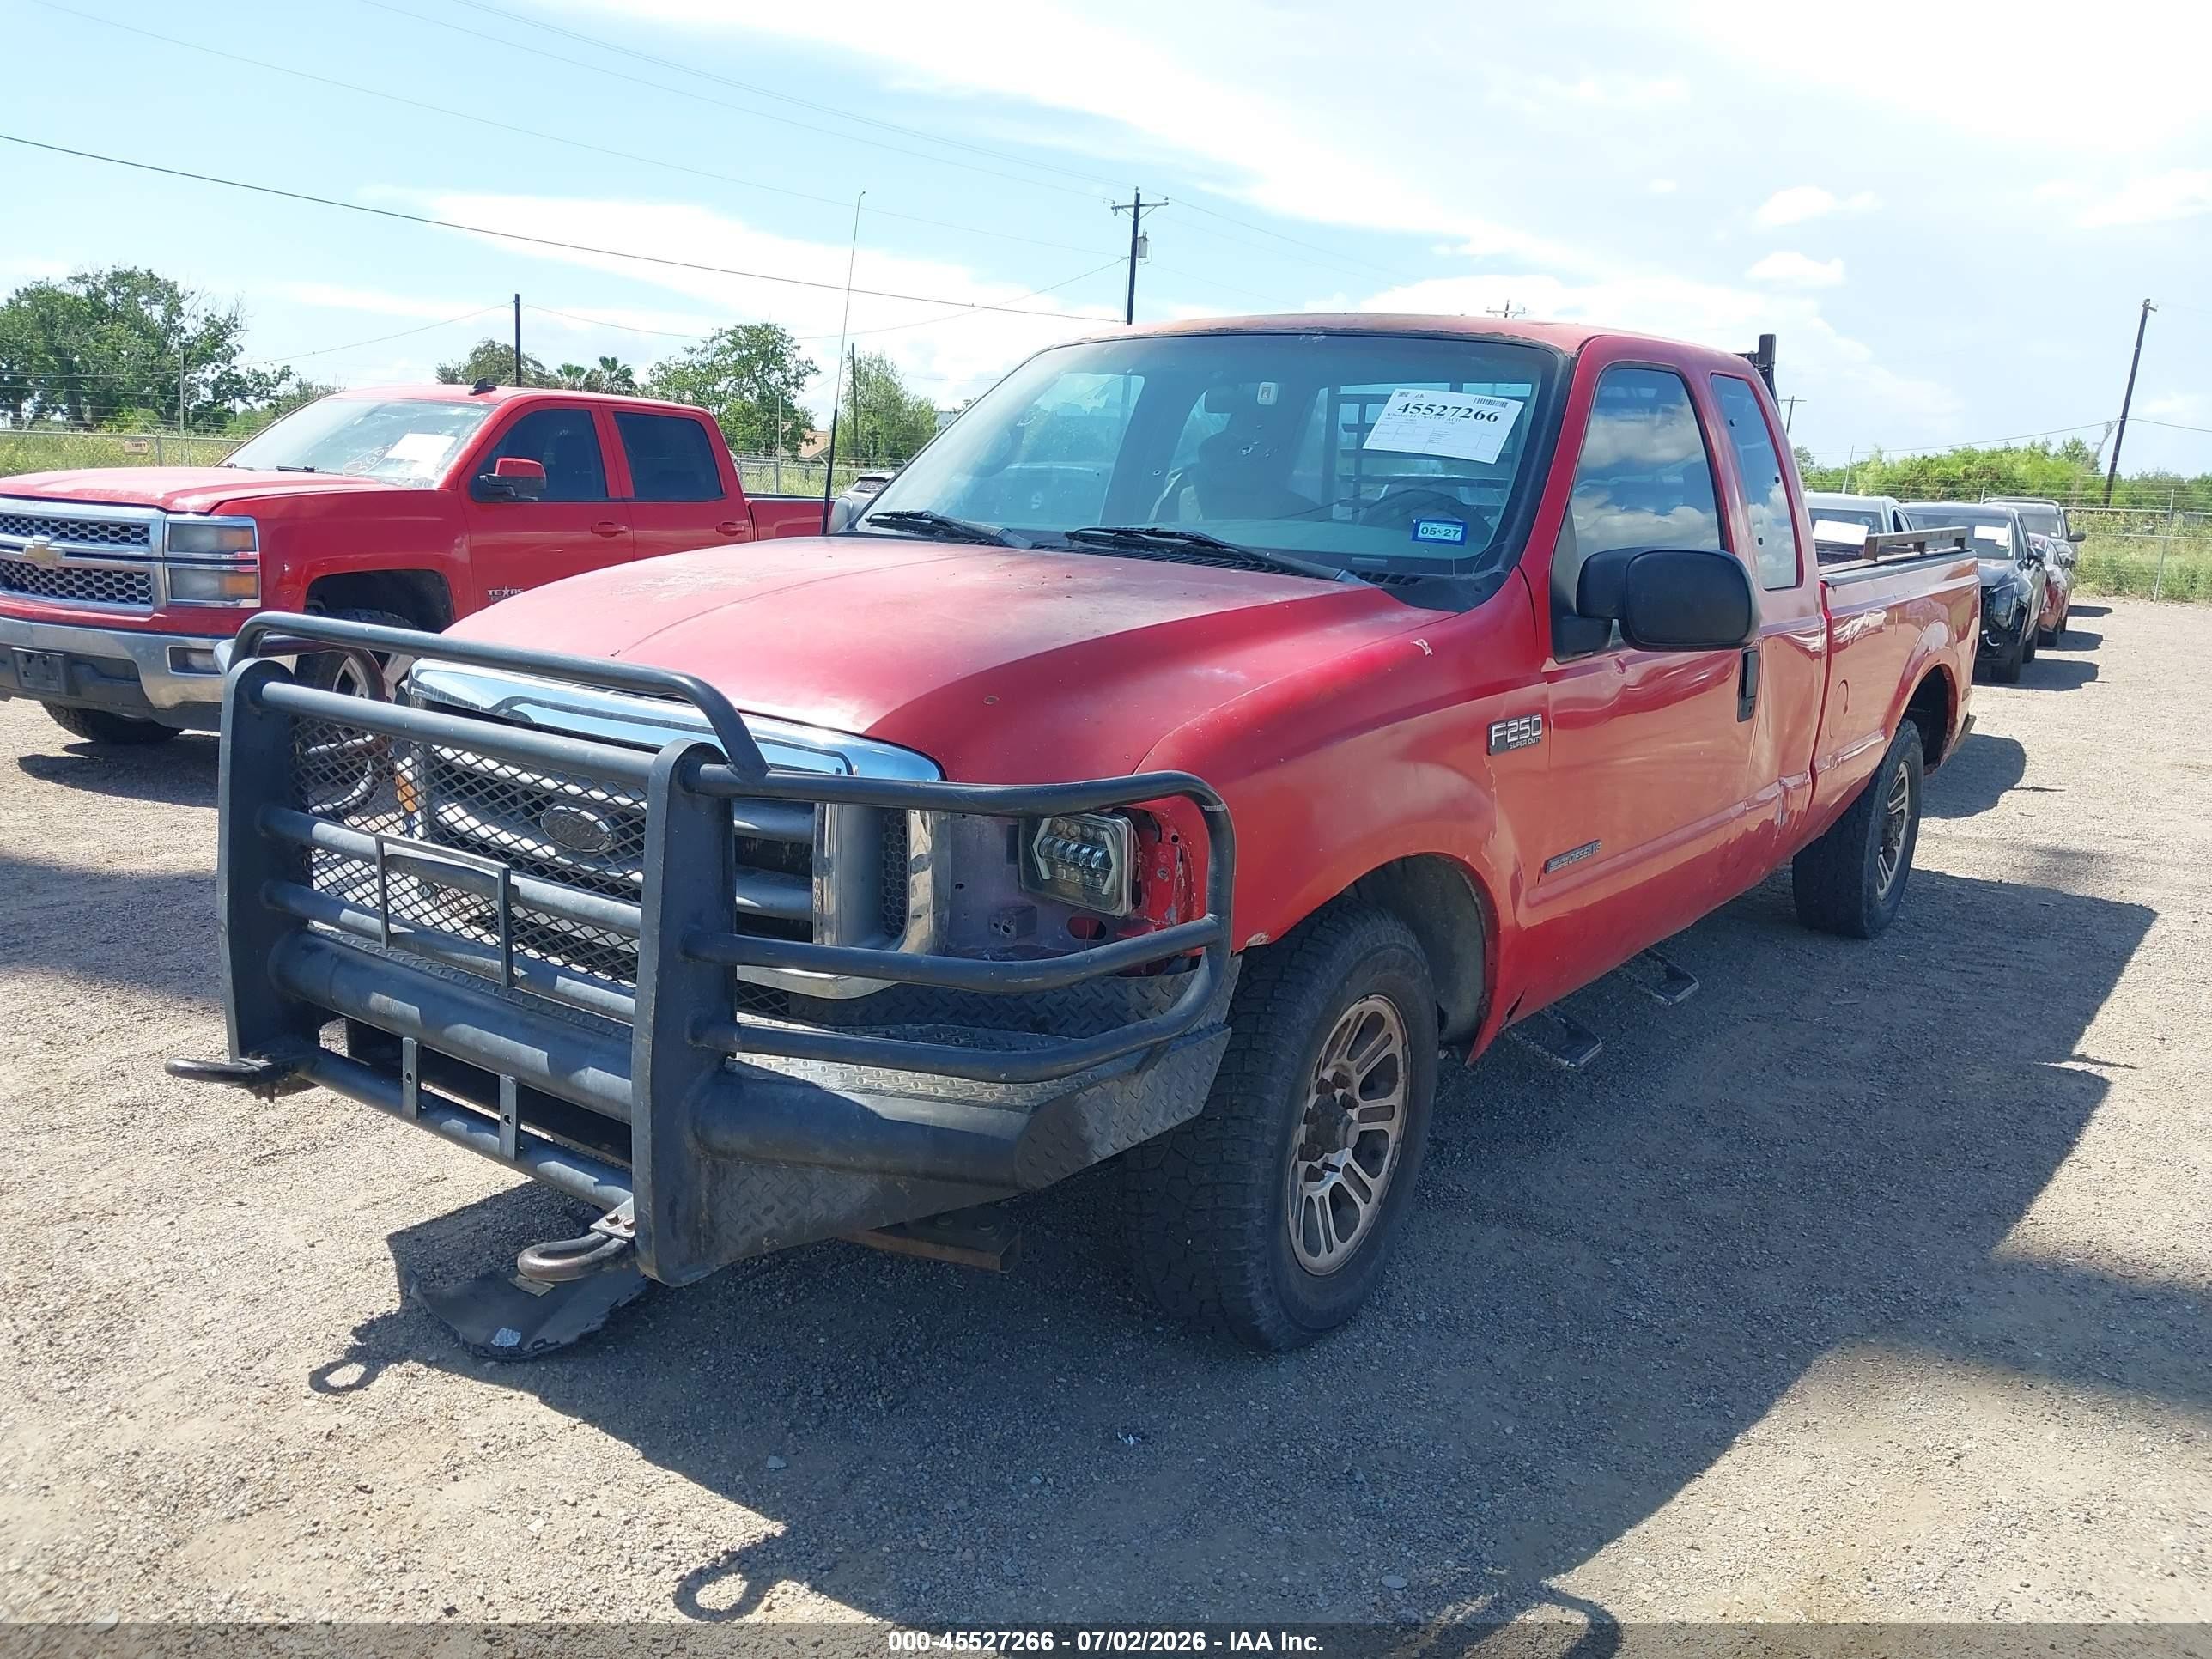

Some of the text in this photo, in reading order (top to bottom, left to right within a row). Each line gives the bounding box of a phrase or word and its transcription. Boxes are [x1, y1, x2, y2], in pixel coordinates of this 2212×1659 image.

[1397, 402, 1501, 422] 45527266
[1421, 526, 1437, 535] 05
[1509, 736, 1542, 749] SUPER DUTY
